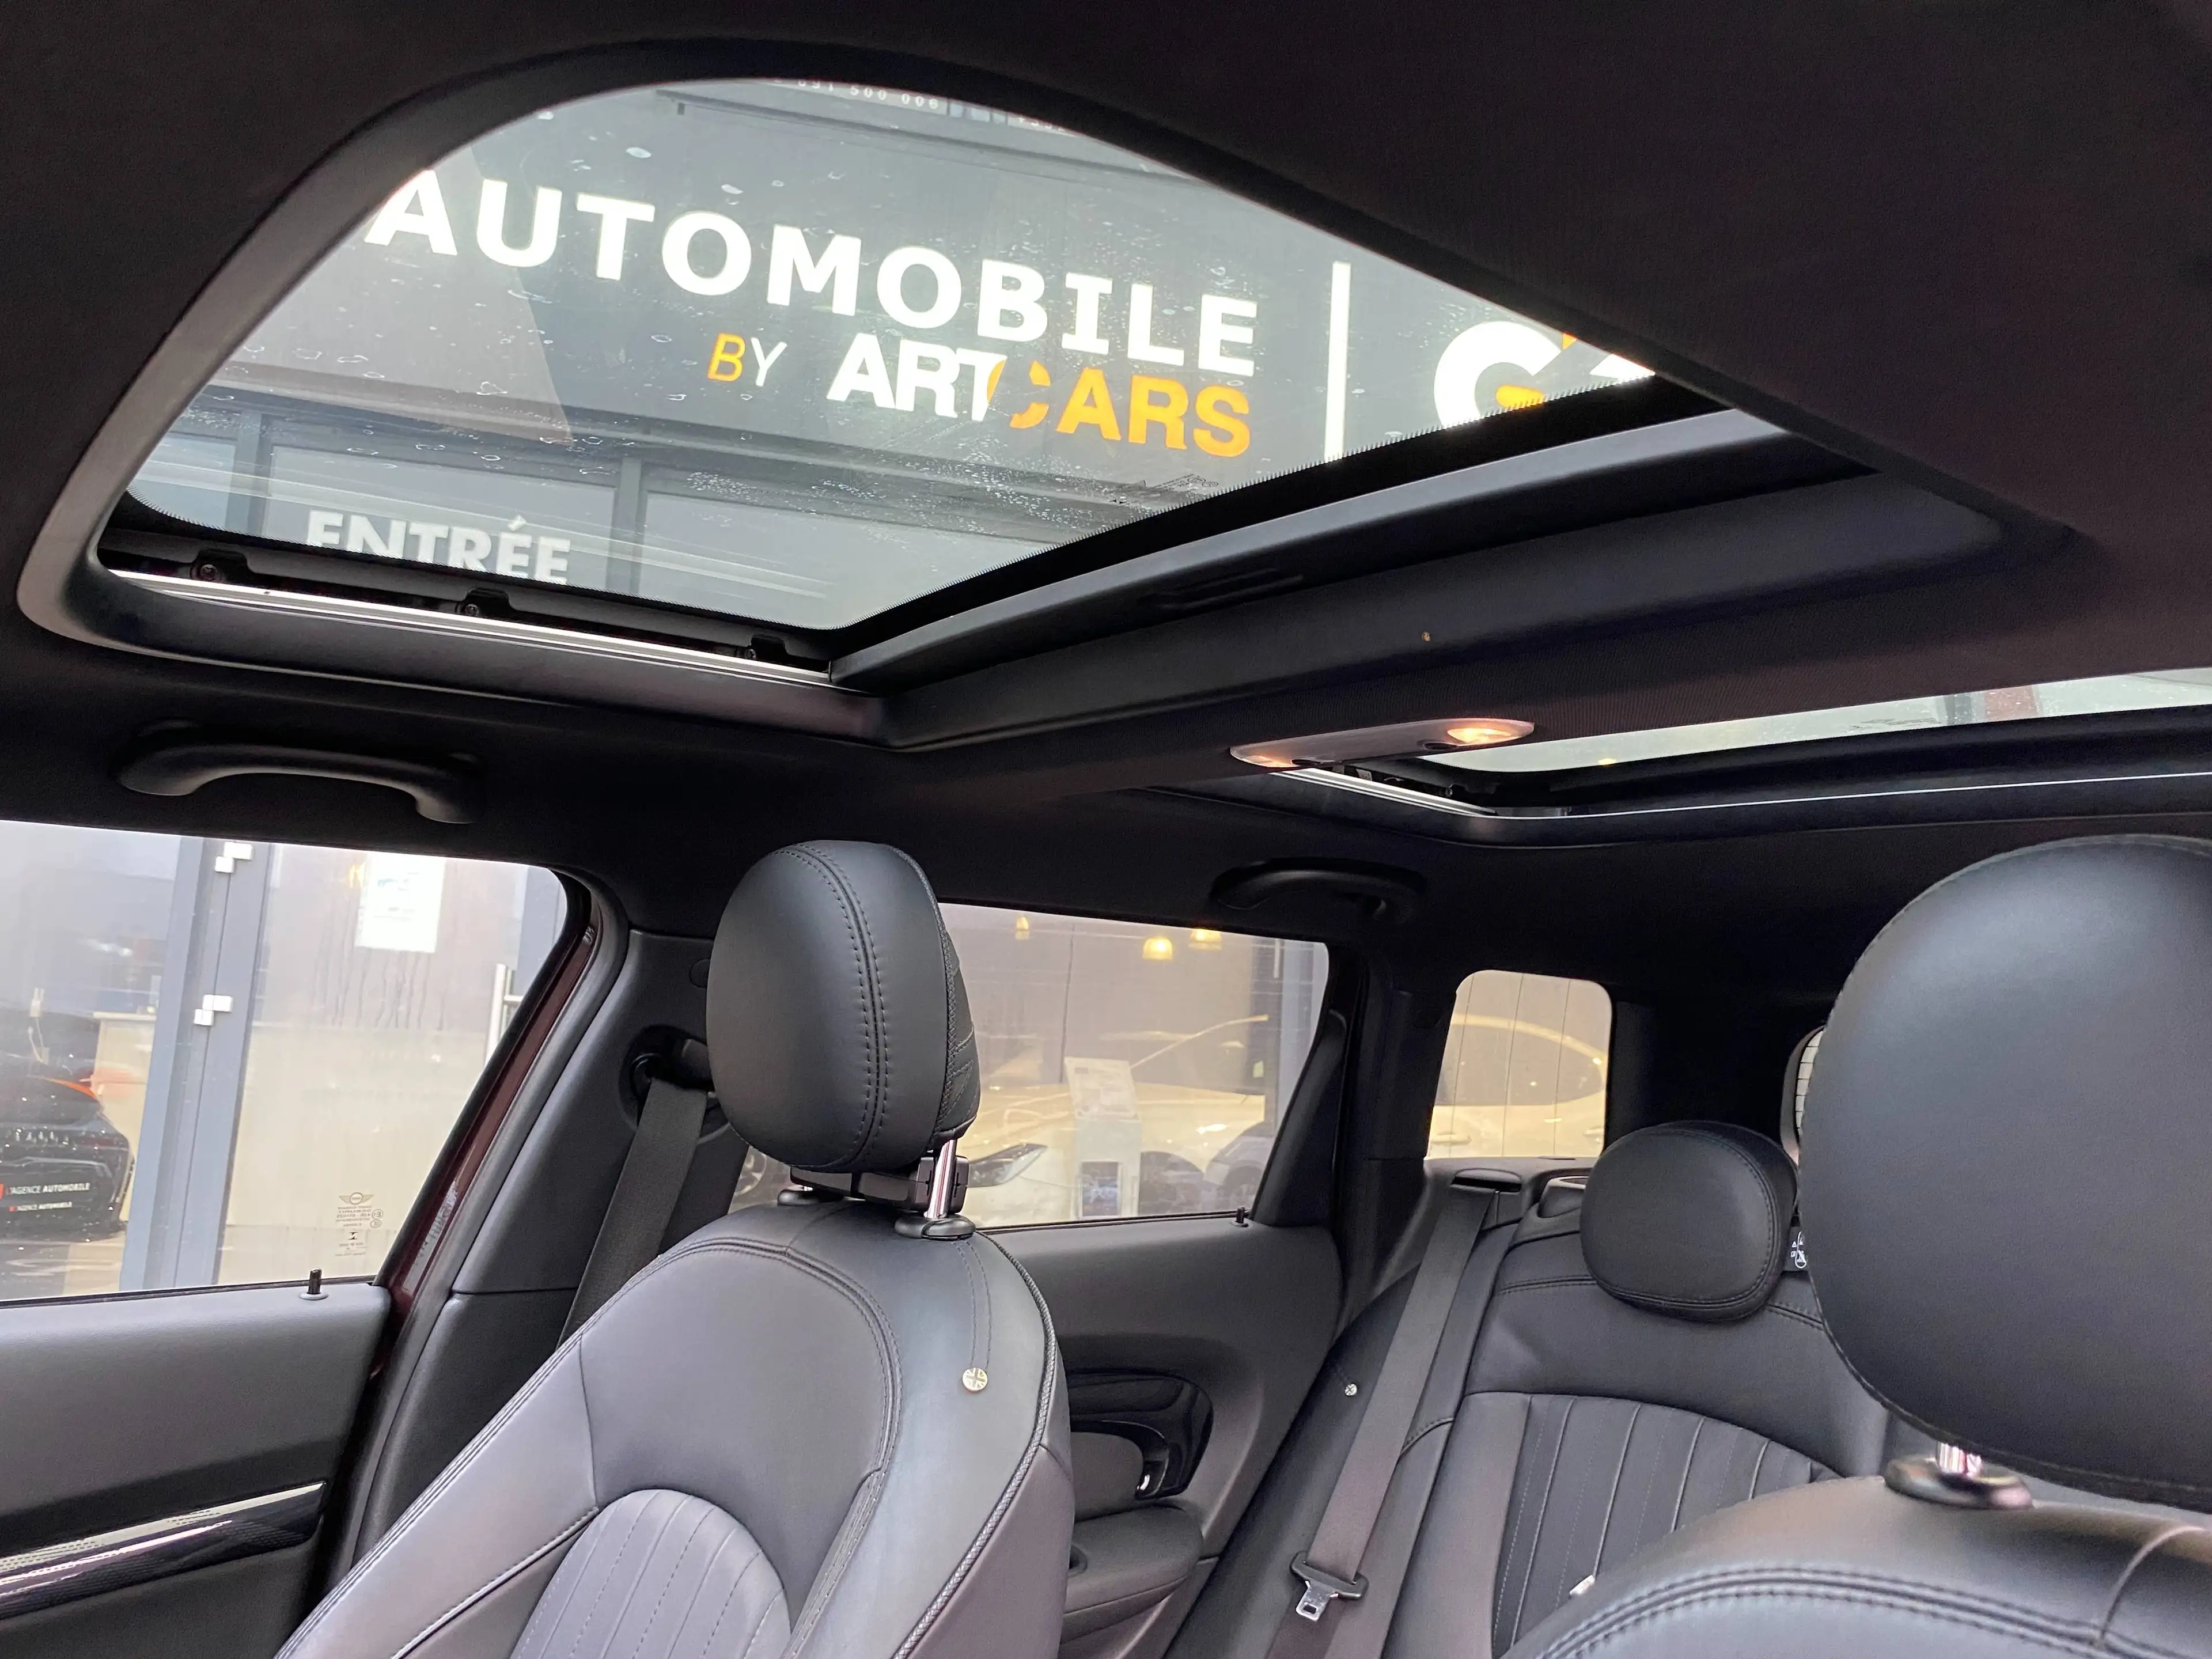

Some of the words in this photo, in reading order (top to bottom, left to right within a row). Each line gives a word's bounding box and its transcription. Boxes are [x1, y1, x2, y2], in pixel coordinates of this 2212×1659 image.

[364, 169, 1258, 377] AUTOMOBILE
[707, 332, 787, 387] BY
[307, 509, 570, 584] ENTRÉE
[42, 1182, 91, 1193] AUTOMOBILE
